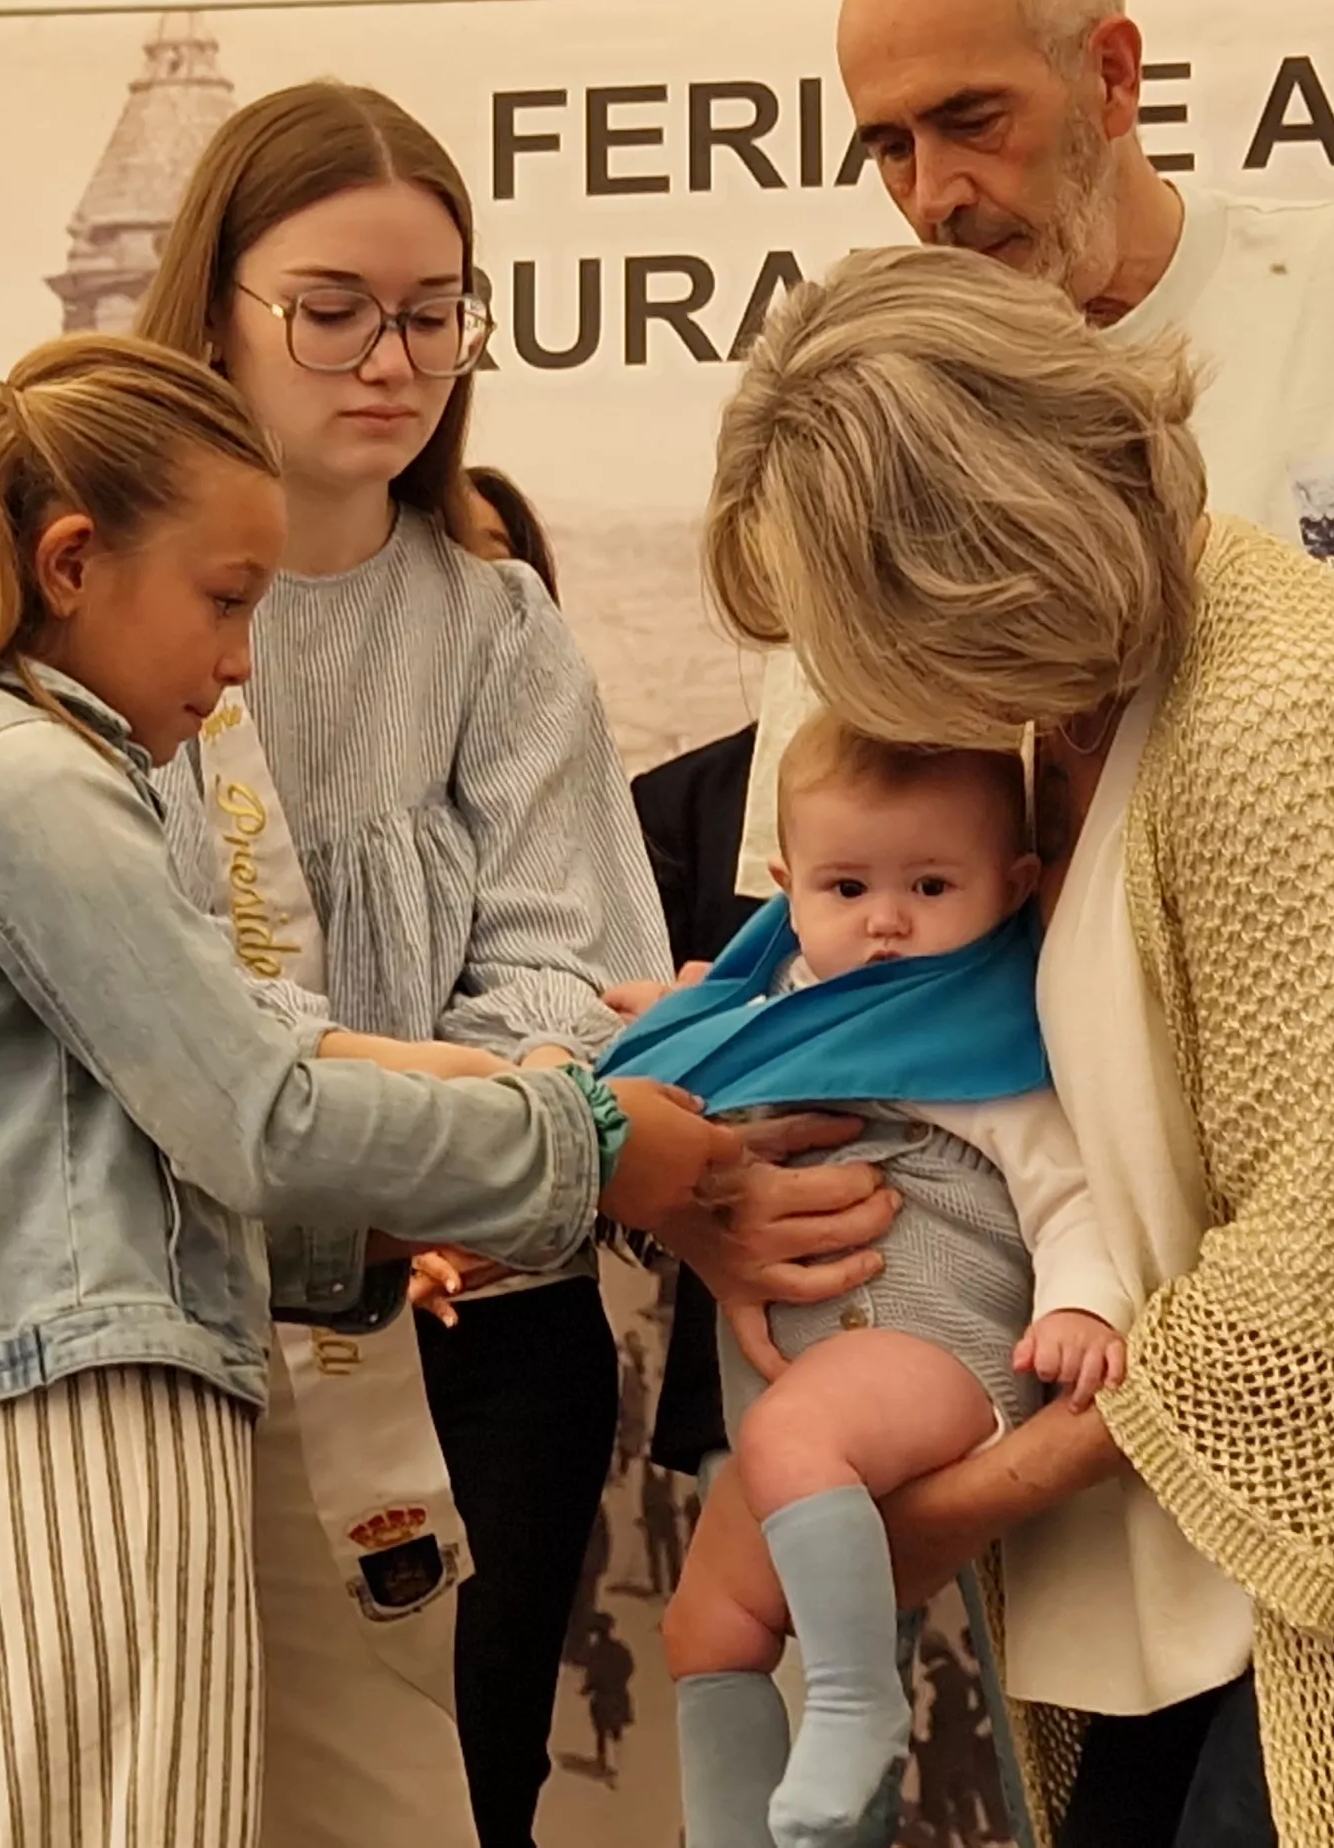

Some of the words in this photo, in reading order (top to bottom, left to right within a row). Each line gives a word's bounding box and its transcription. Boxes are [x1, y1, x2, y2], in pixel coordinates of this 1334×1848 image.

[1138, 61, 1195, 173] E
[469, 249, 847, 371] URA
[215, 774, 303, 979] Preside
